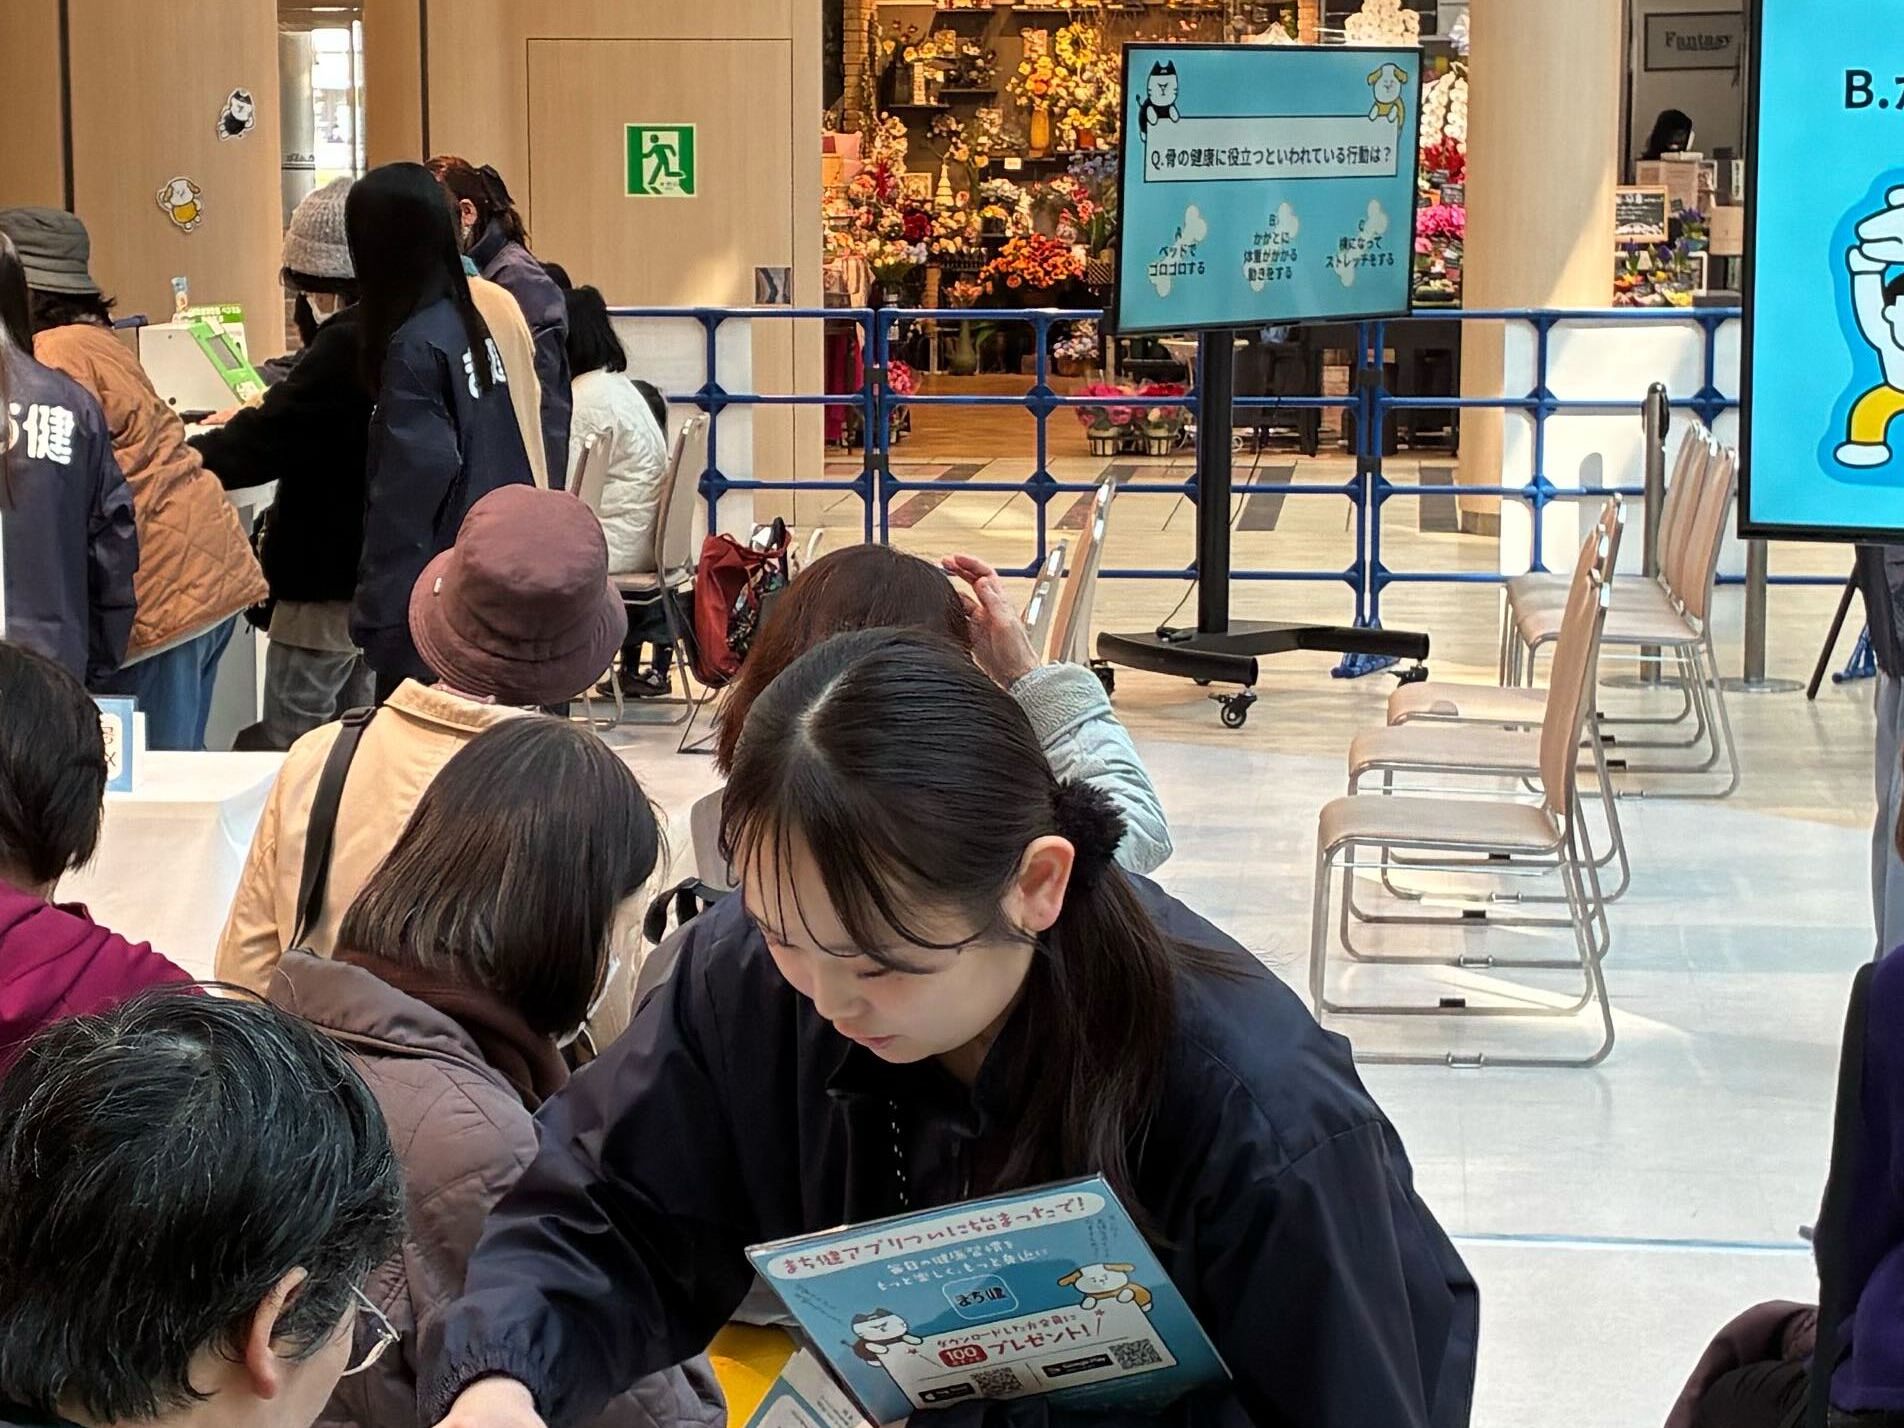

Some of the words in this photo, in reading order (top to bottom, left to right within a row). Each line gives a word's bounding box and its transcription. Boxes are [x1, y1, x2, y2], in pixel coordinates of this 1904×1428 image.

[1664, 30, 1733, 52] Fantasy
[1150, 145, 1393, 171] Q.骨の健康に役立つといわれている行動は？
[1149, 261, 1206, 277] ゴロゴロする
[1325, 252, 1395, 270] ストレッチをする
[944, 1344, 978, 1361] 100
